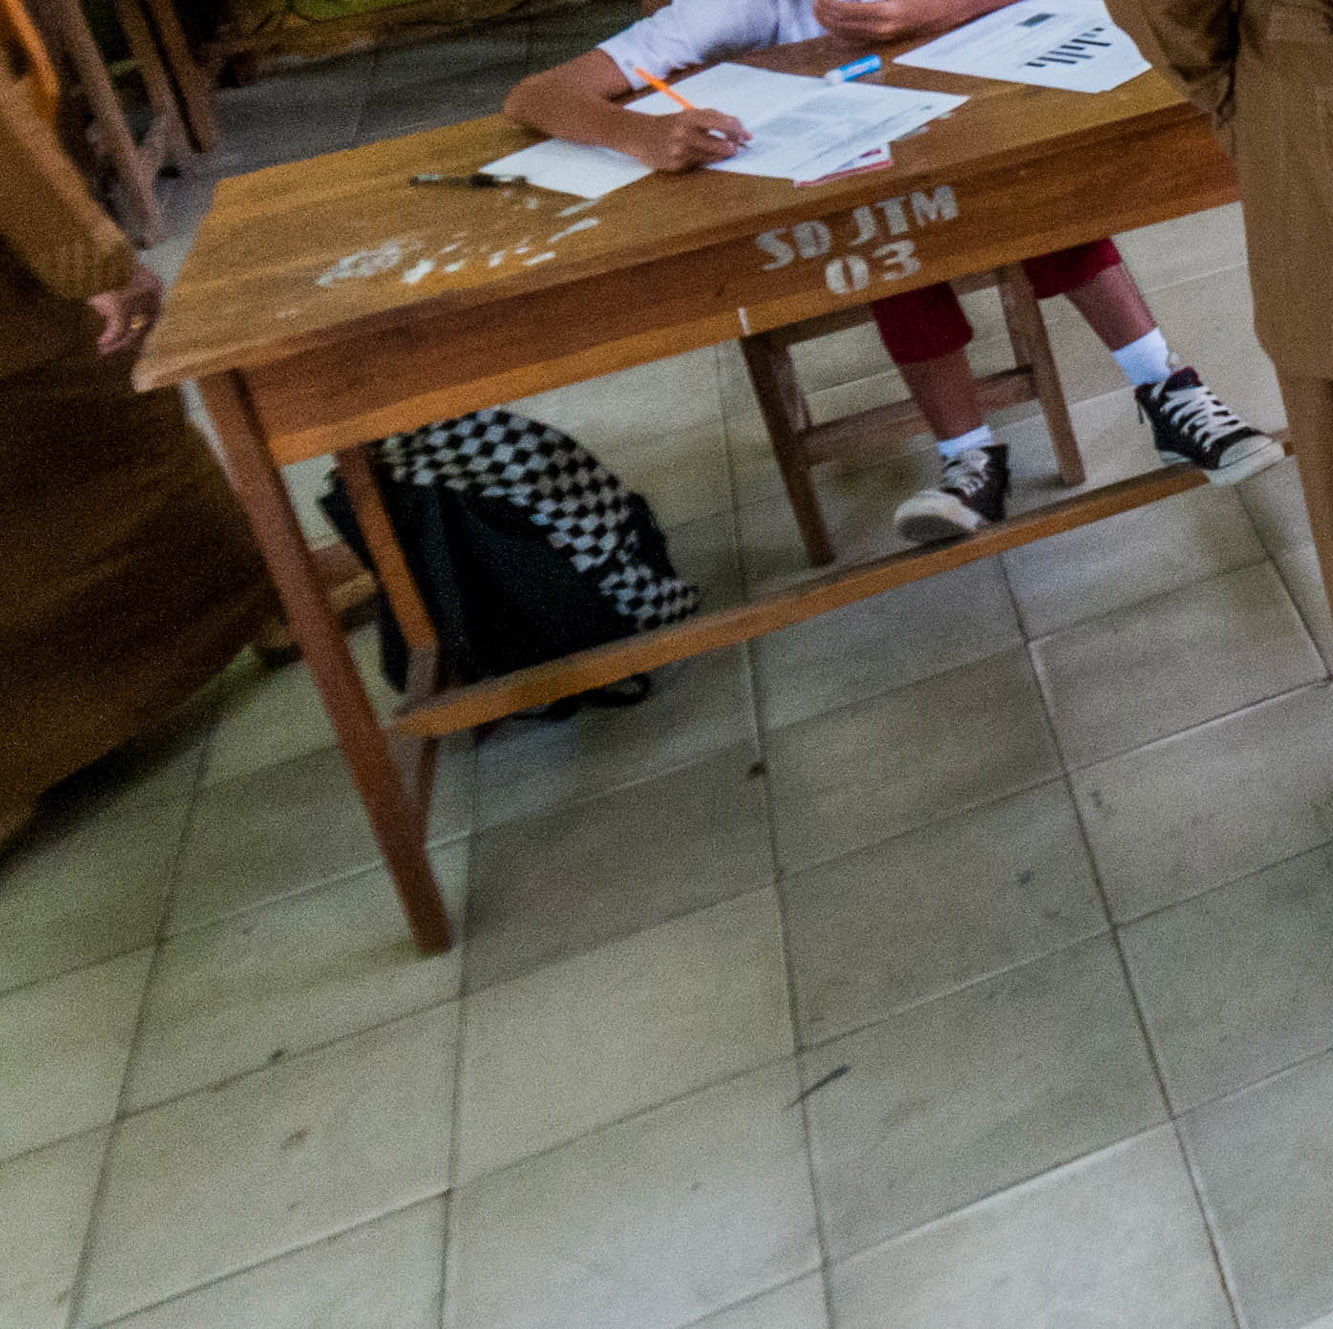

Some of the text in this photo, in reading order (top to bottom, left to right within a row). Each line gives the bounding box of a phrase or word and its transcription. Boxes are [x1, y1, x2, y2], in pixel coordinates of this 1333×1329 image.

[756, 185, 959, 270] SD JTM
[825, 239, 921, 295] 03
